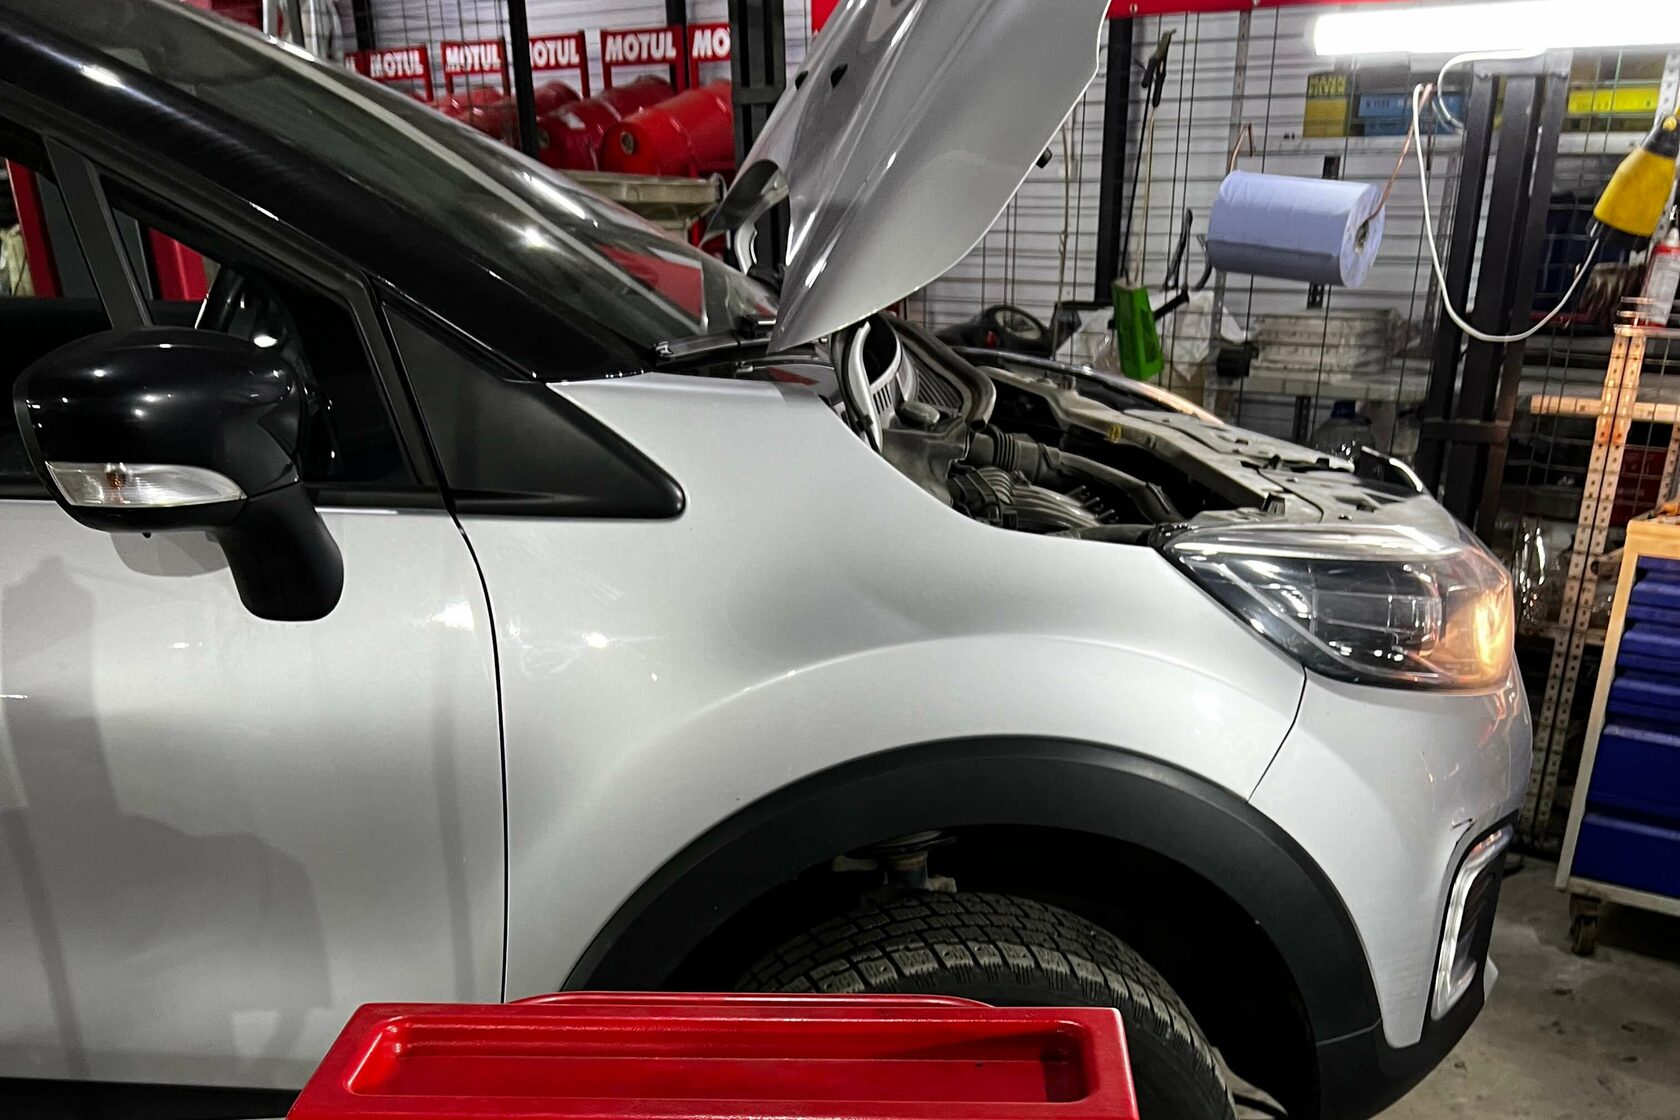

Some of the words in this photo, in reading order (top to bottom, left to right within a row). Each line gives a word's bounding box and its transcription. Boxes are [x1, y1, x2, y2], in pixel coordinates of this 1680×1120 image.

[445, 44, 501, 72] MOTUL
[530, 38, 580, 67] OTUL
[604, 30, 677, 63] MOTUL
[370, 50, 424, 78] MOTUL
